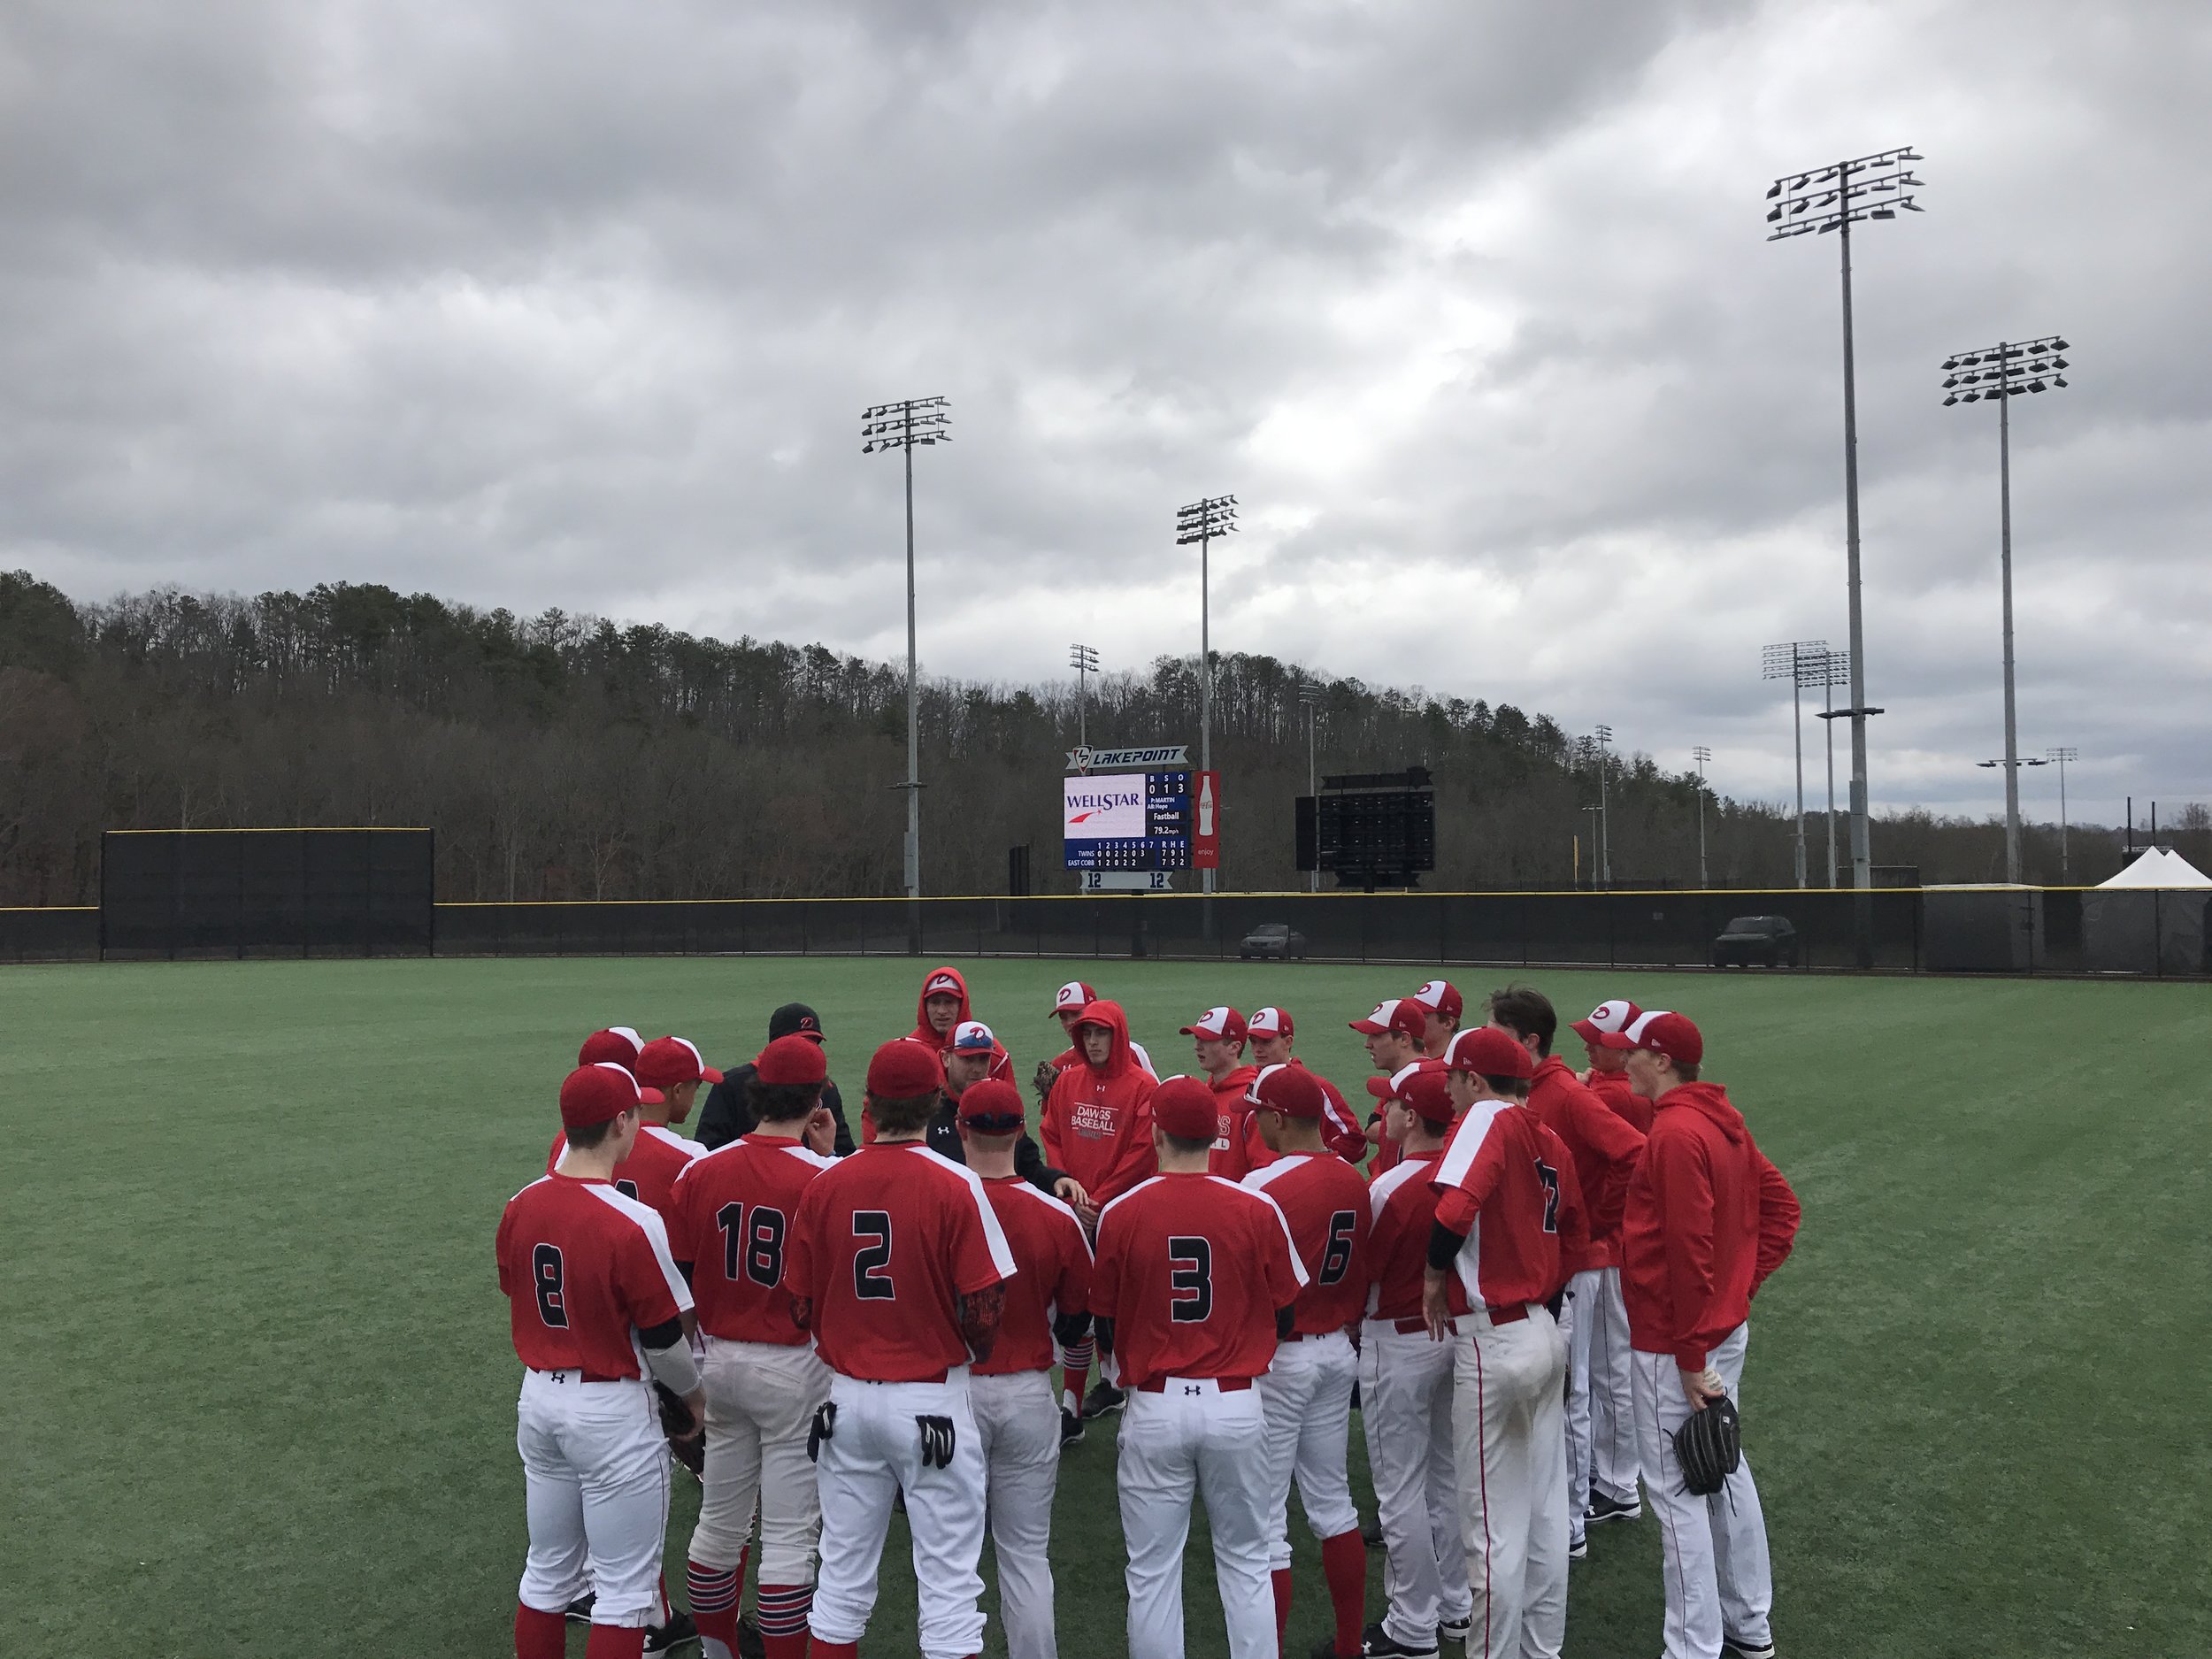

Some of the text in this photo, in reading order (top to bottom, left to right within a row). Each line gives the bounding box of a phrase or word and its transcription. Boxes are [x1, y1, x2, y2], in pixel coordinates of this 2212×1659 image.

[1094, 749, 1180, 765] LAKEPOINT
[1149, 783, 1184, 795] 0 1 3
[1067, 793, 1140, 810] WELLSTAR
[1154, 811, 1179, 820] Fastball
[1088, 873, 1164, 887] 12 12
[1077, 1106, 1111, 1120] DAWGS
[1071, 1116, 1116, 1133] BASEBALL
[717, 1202, 786, 1289] 18
[1318, 1210, 1356, 1286] 6
[853, 1210, 895, 1301] 2
[532, 1242, 569, 1330] 8
[1168, 1235, 1212, 1323] 3
